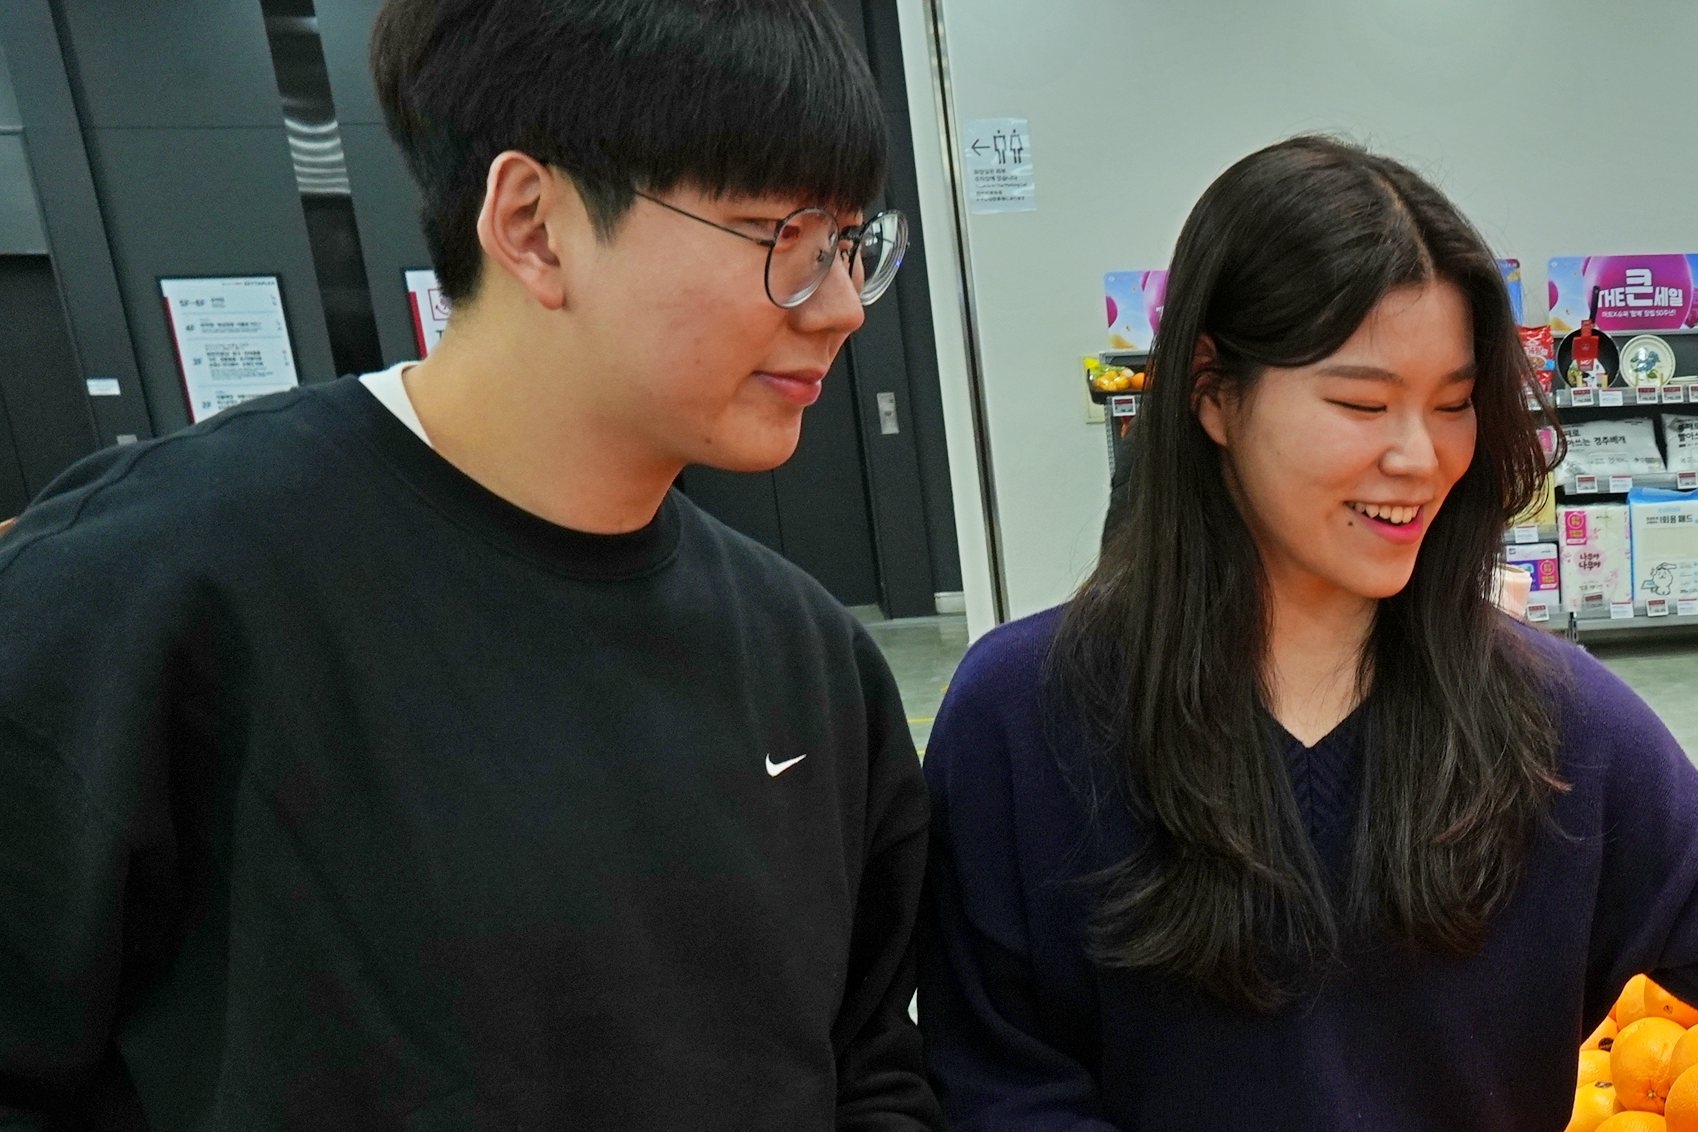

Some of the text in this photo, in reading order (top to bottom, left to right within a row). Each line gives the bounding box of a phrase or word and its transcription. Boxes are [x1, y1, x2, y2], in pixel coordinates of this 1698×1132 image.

[1598, 268, 1683, 308] THE 큰 세일
